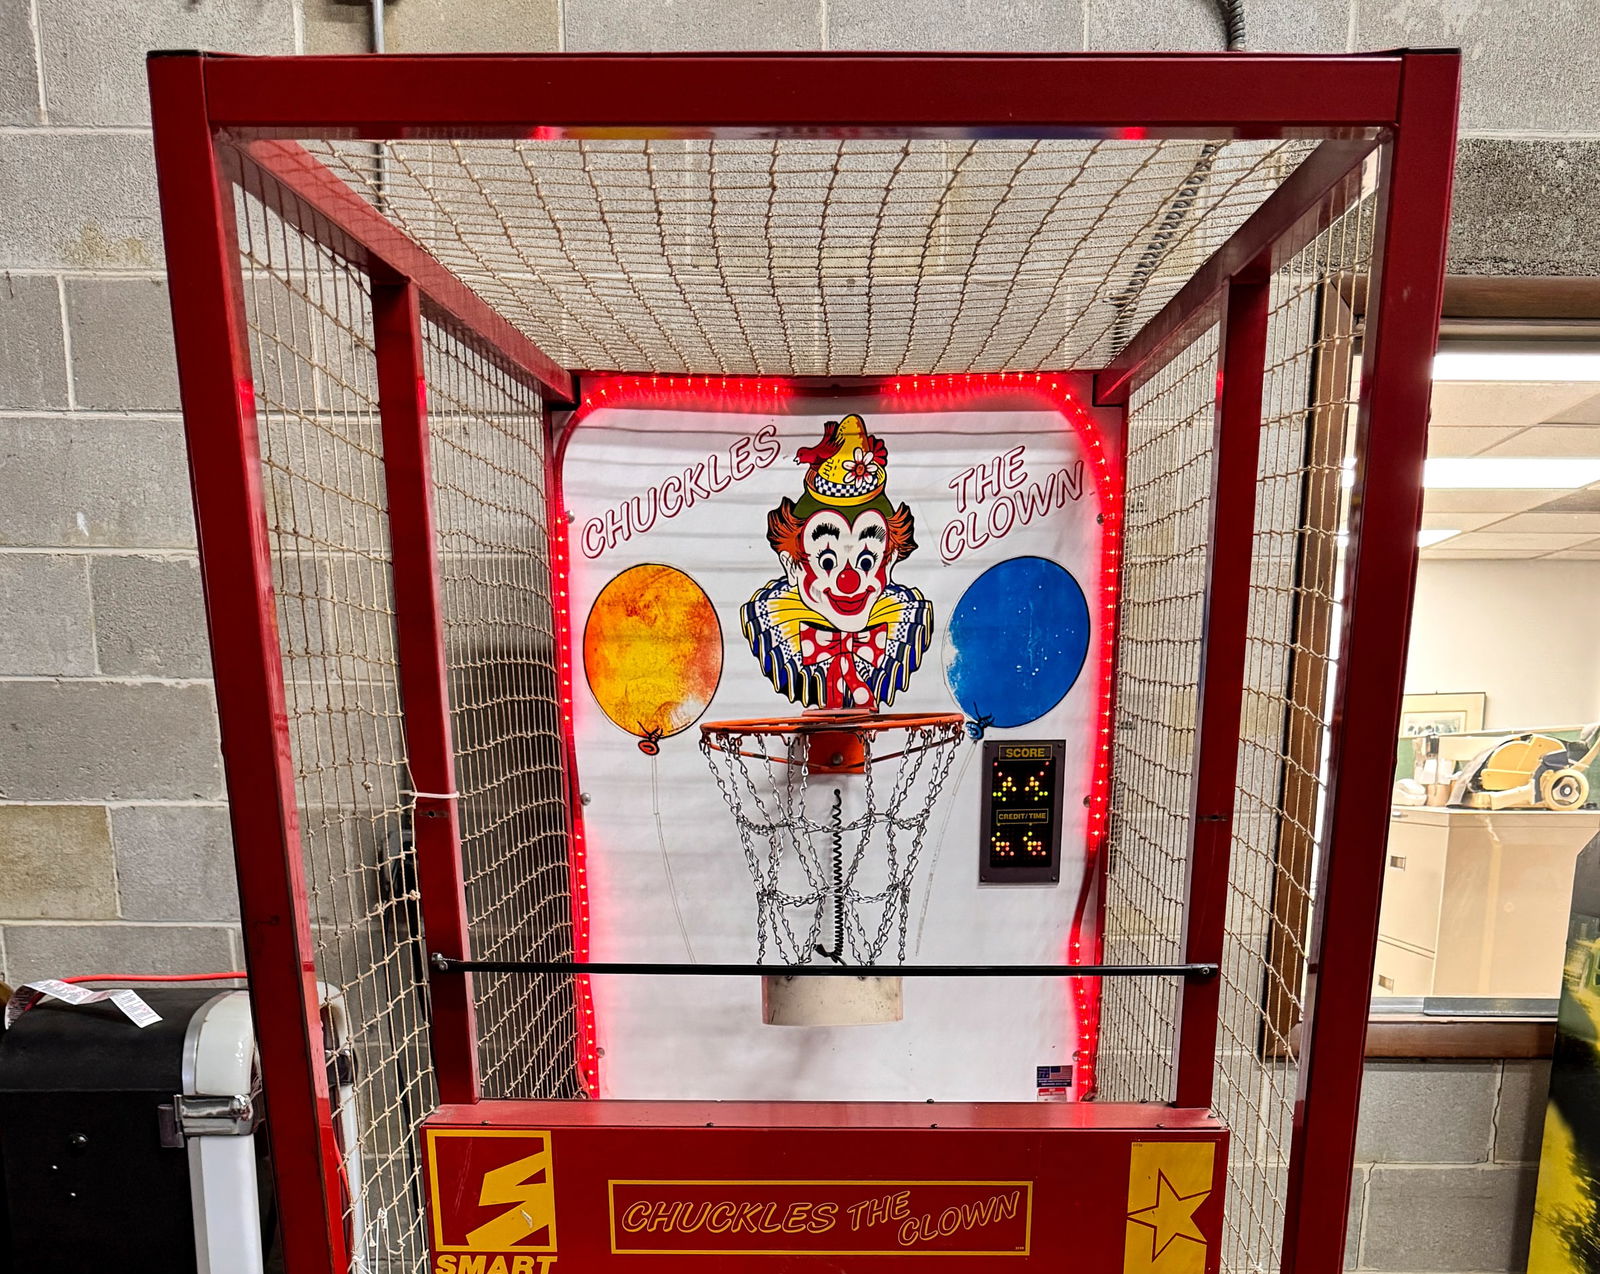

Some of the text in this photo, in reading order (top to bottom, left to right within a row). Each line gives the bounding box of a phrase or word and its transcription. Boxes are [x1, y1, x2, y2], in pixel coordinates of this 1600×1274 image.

[581, 424, 781, 559] CHUCKLES
[940, 460, 1084, 562] CLOWN
[949, 446, 1029, 512] THE
[1006, 748, 1045, 758] SCORE
[621, 1190, 1019, 1246] CHUCKLES THE CLOWN
